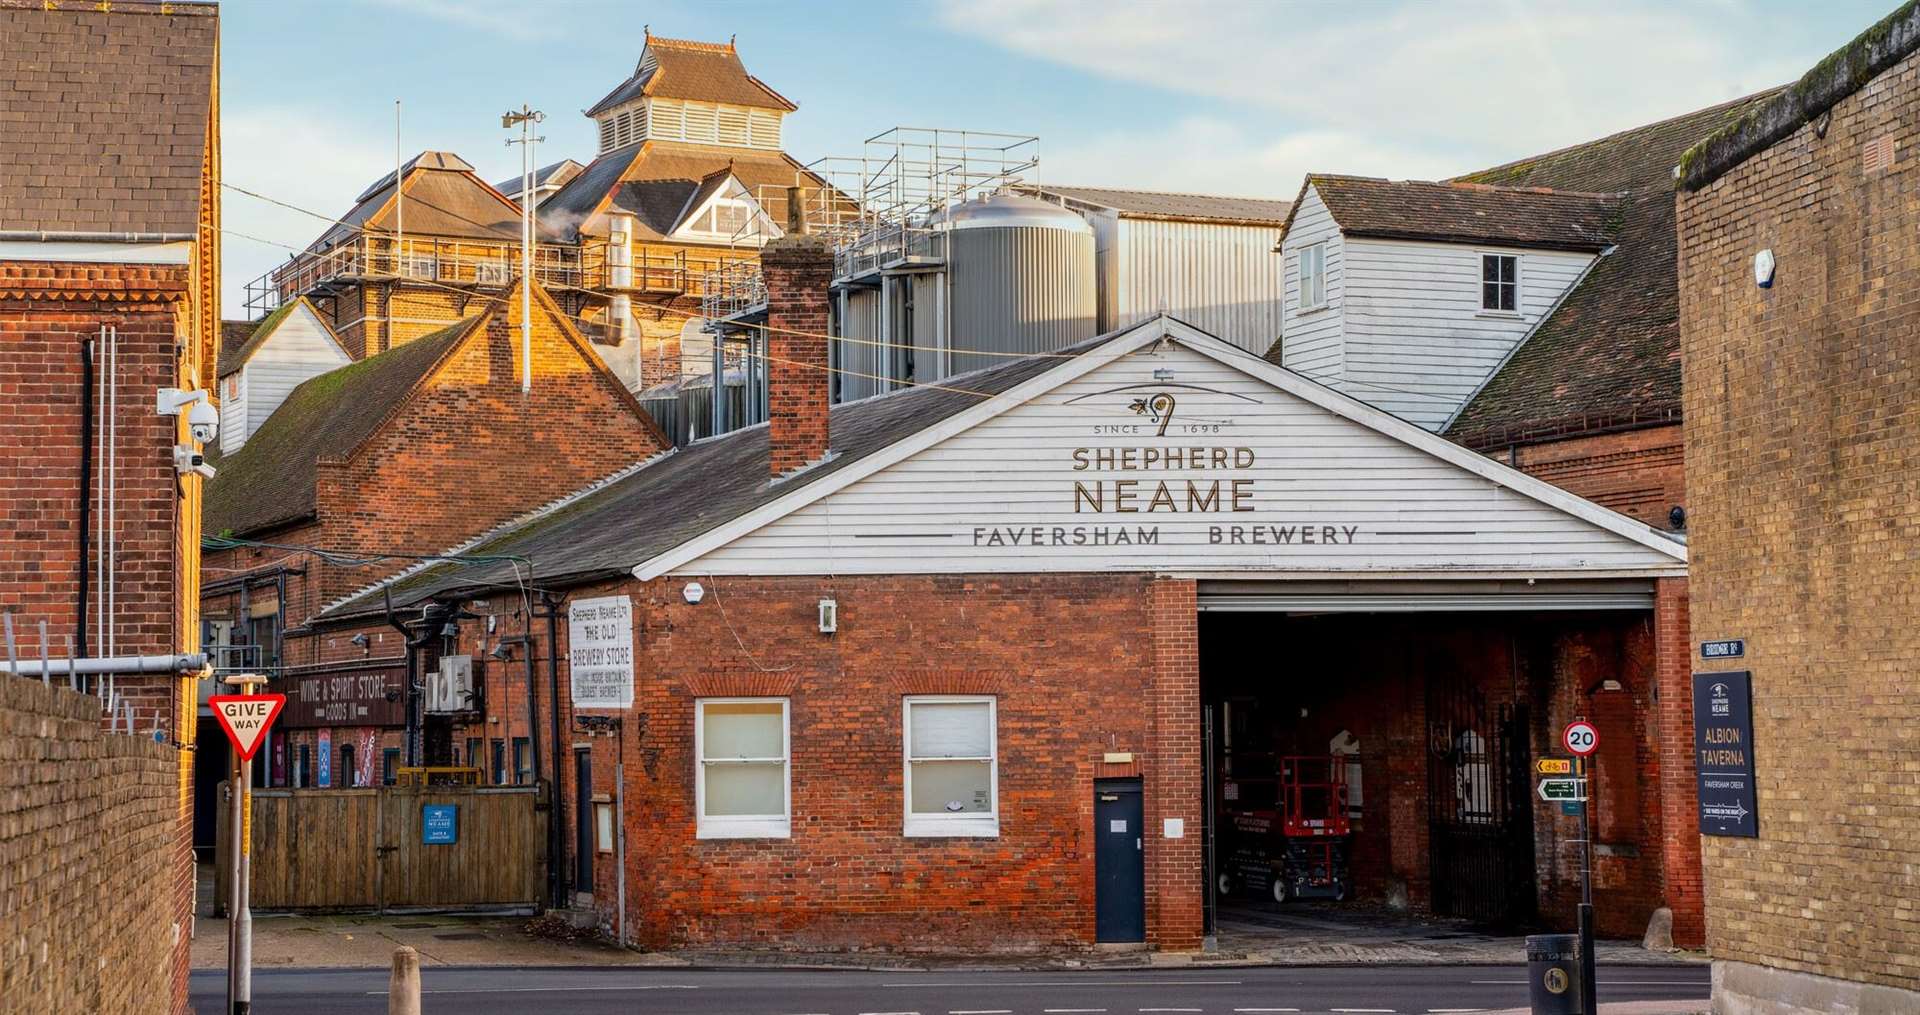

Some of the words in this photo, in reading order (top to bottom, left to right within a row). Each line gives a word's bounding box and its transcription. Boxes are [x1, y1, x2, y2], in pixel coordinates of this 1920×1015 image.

[1093, 424, 1140, 434] SINCE
[1182, 424, 1220, 434] 1698
[1072, 446, 1256, 471] SHEPHERD
[1074, 479, 1256, 514] NEAME
[973, 526, 1160, 547] FAVERSHAM
[1208, 525, 1359, 546] BREWERY
[584, 624, 599, 641] THE
[601, 623, 617, 640] OLD
[573, 648, 605, 667] BREWERY
[606, 646, 630, 665] STORE
[300, 679, 320, 703] WINE
[322, 680, 329, 701] &
[330, 676, 355, 701] SPIRIT
[359, 674, 387, 700] STORE
[225, 703, 266, 717] GIVE
[326, 702, 347, 721] GOODS
[349, 702, 357, 720] IN
[235, 719, 260, 729] WAY
[1570, 731, 1593, 746] 20
[1705, 728, 1740, 744] ALBION
[1701, 749, 1745, 766] TAVERNA
